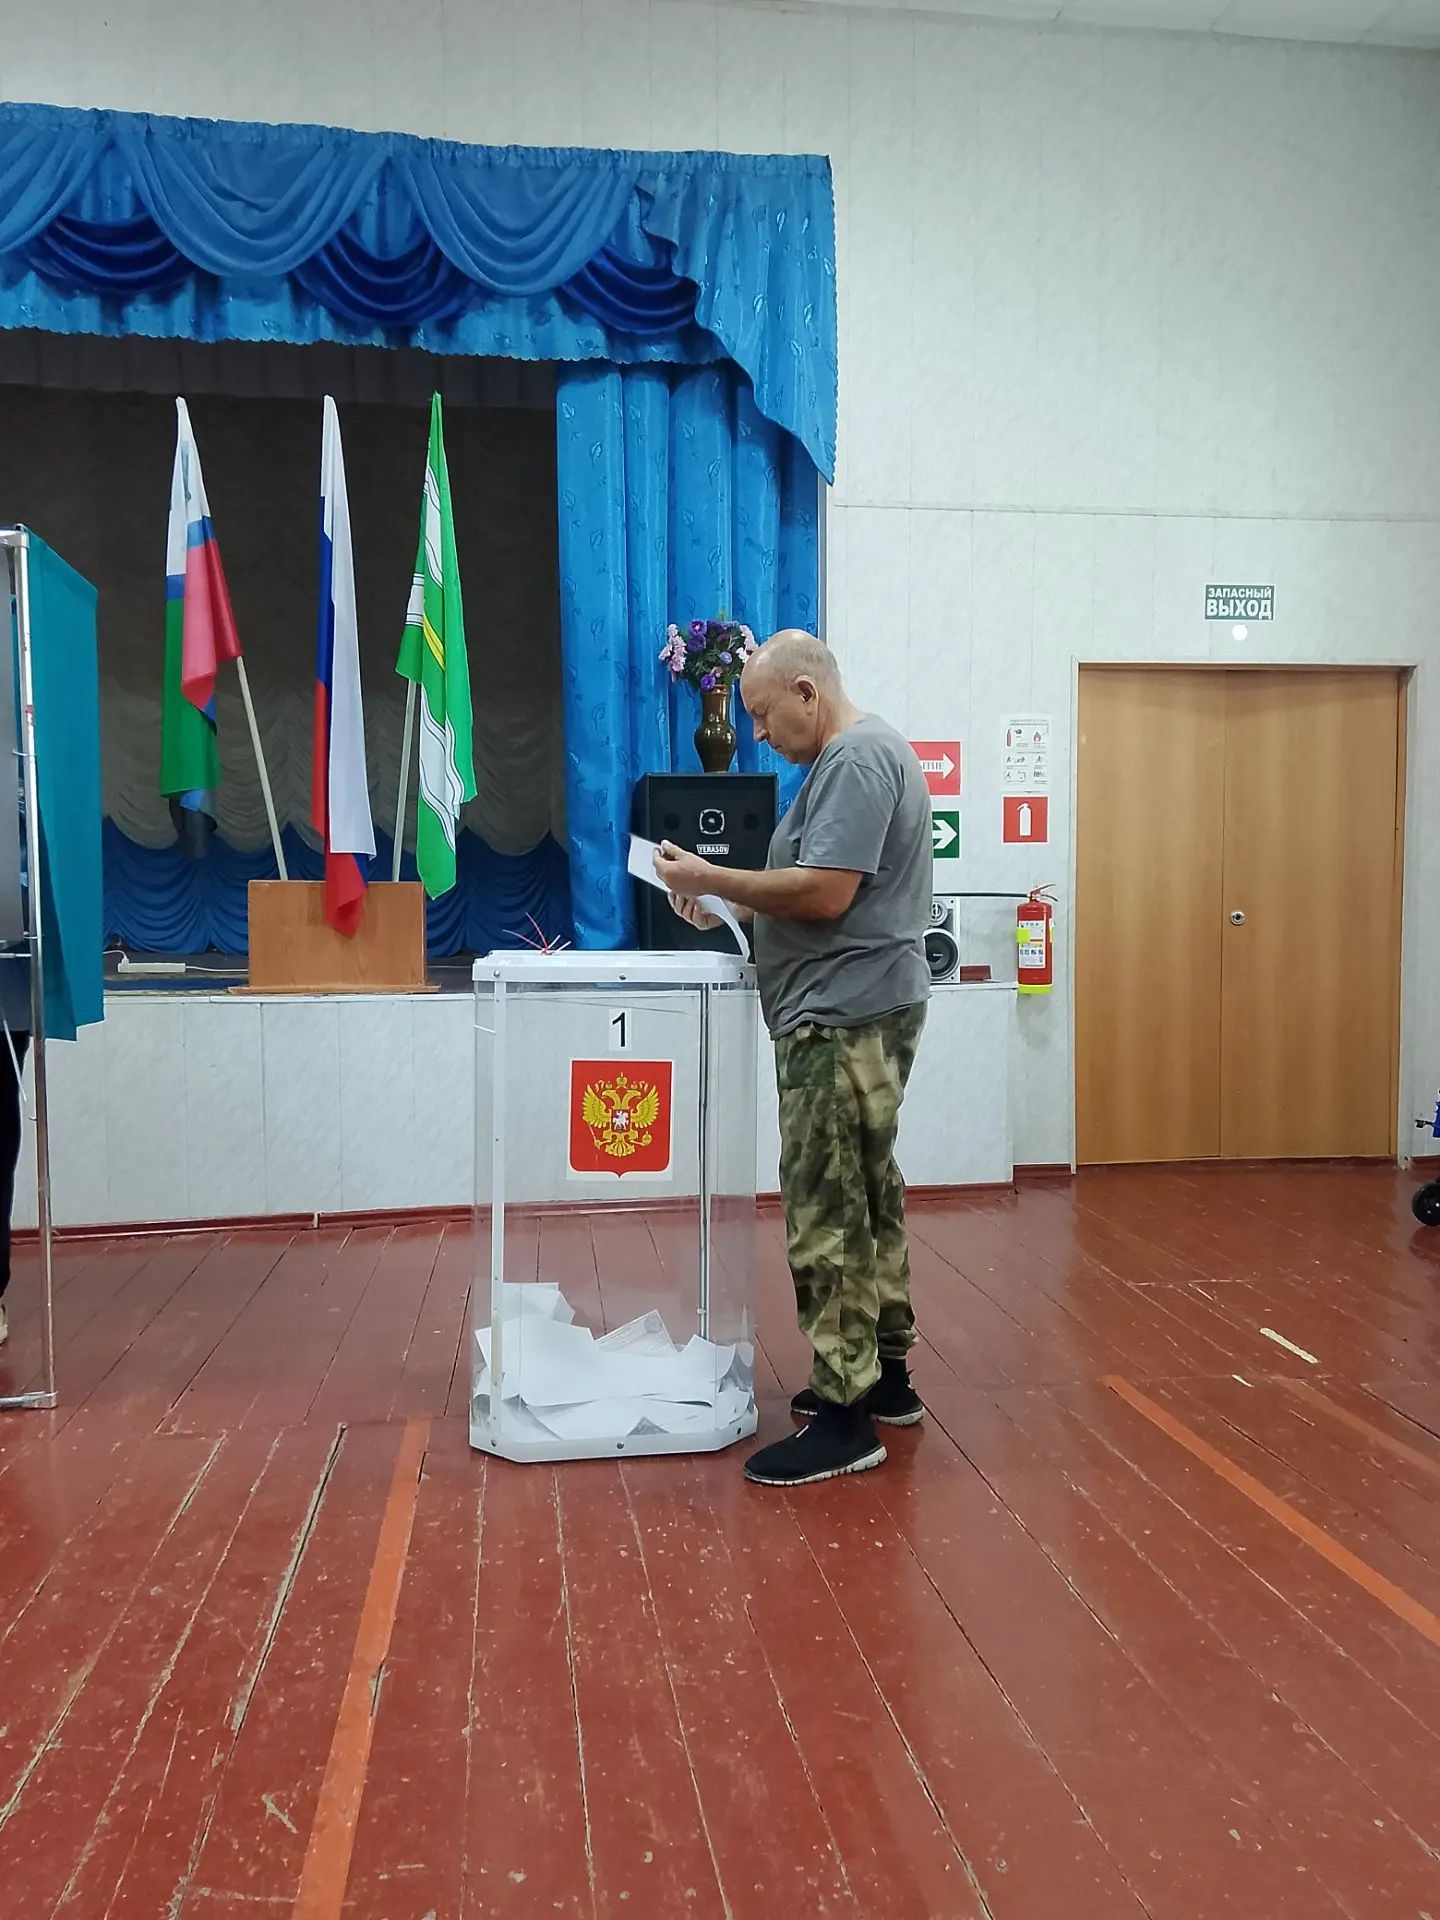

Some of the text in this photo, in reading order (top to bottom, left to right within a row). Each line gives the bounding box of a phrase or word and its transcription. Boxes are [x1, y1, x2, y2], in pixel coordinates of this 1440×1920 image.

[1208, 587, 1271, 599] ЗАПАСНЫЙ
[1206, 599, 1272, 619] ВЫХОД
[612, 1012, 625, 1047] 1
